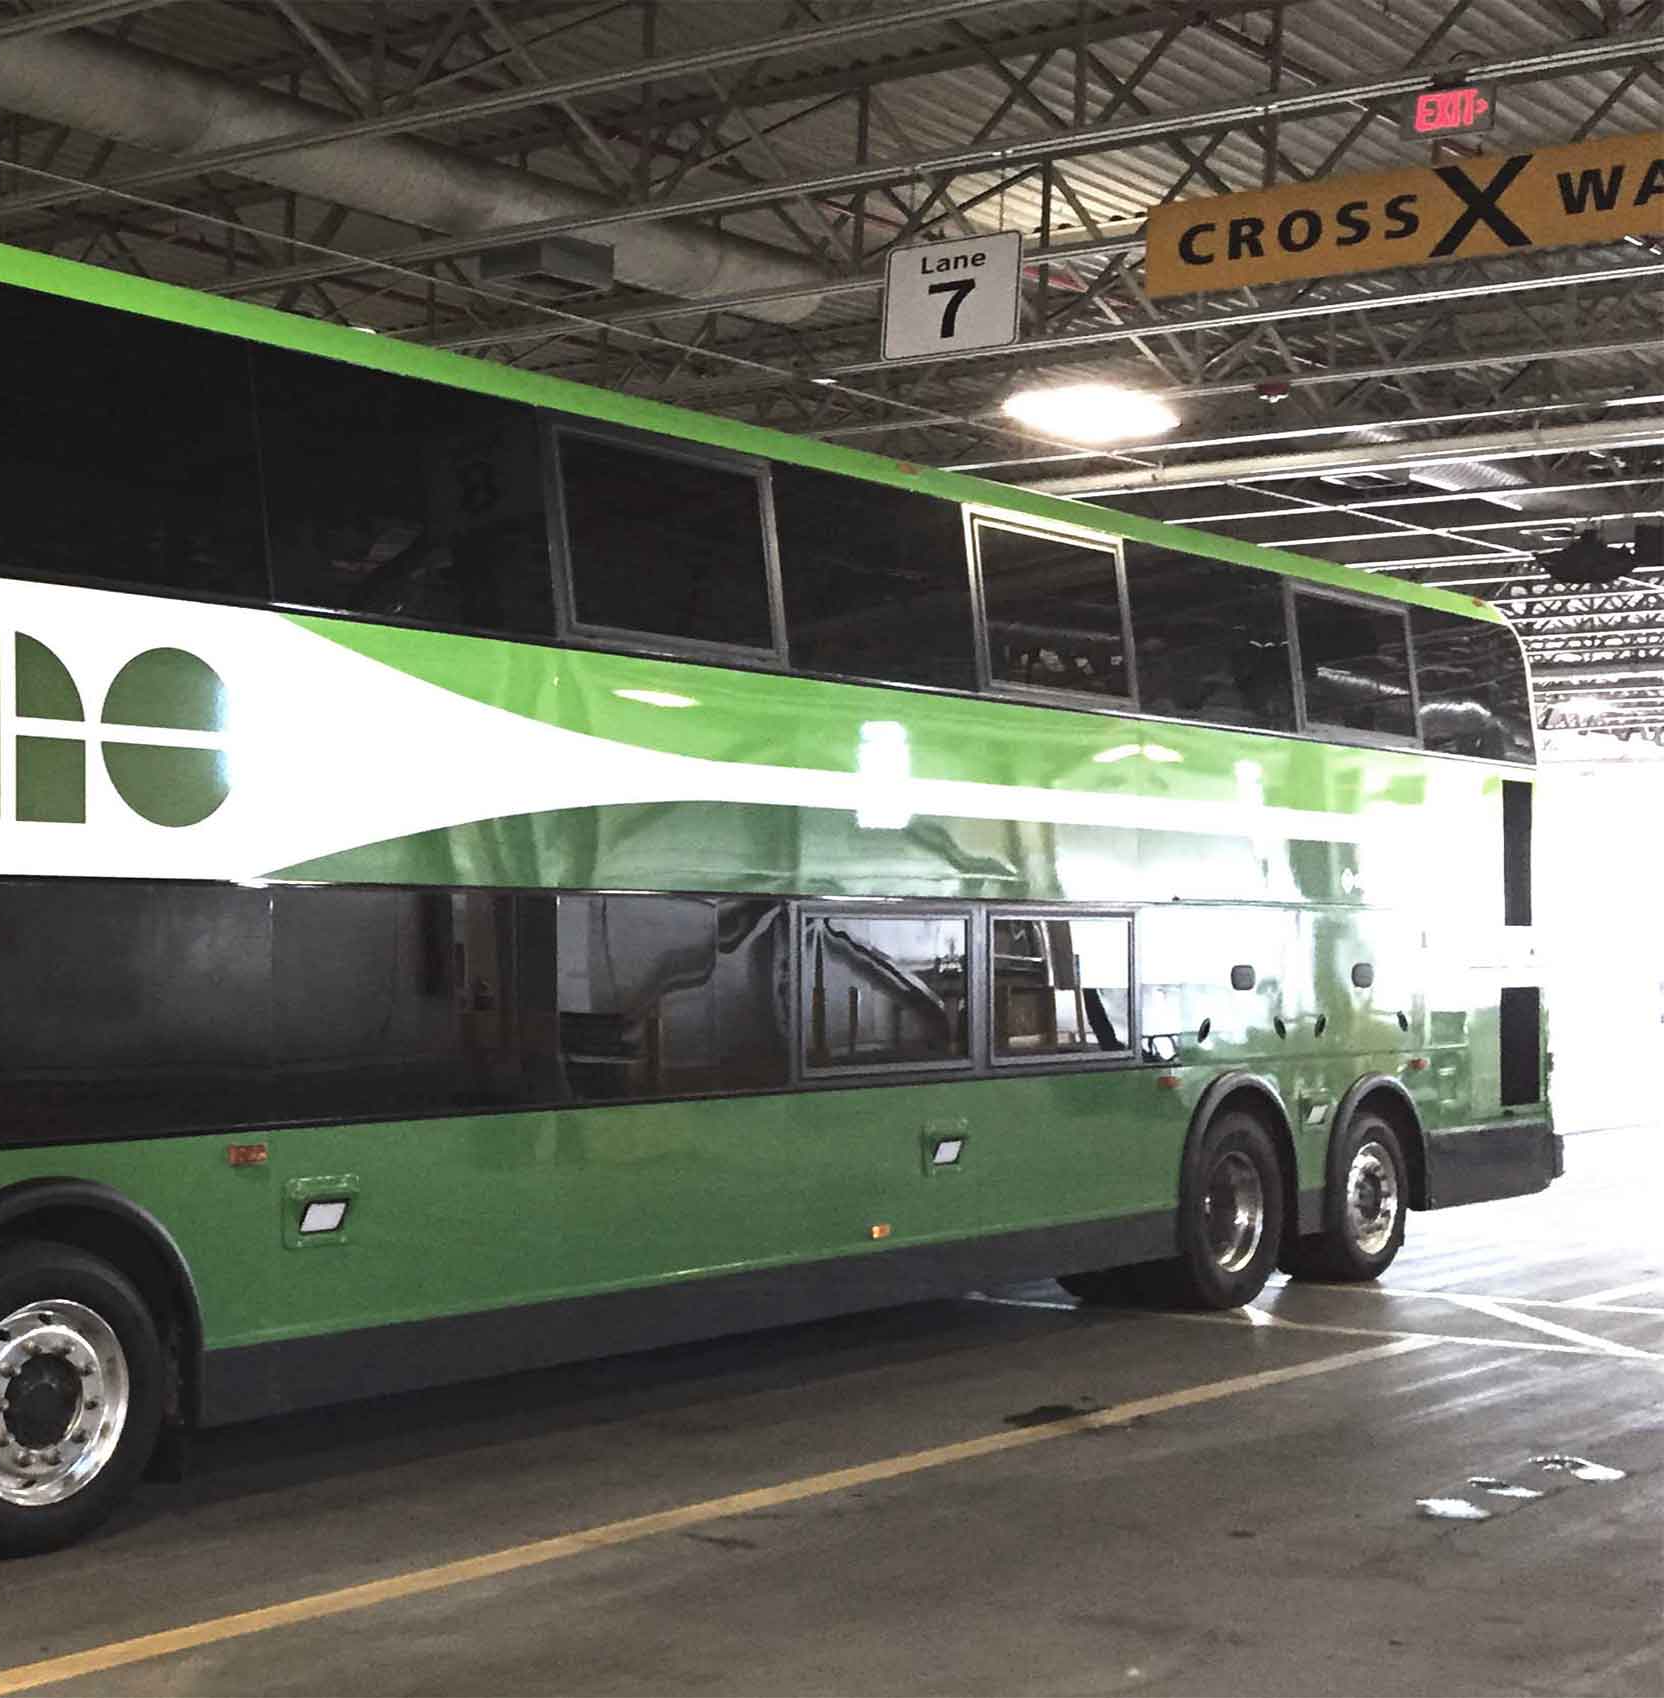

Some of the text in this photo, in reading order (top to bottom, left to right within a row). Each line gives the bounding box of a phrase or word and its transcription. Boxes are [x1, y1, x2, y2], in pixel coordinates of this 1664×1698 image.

[1414, 88, 1479, 133] EXIT
[1178, 194, 1419, 266] CROSS
[1428, 153, 1534, 258] X
[921, 252, 986, 274] Lane
[928, 278, 976, 339] 7
